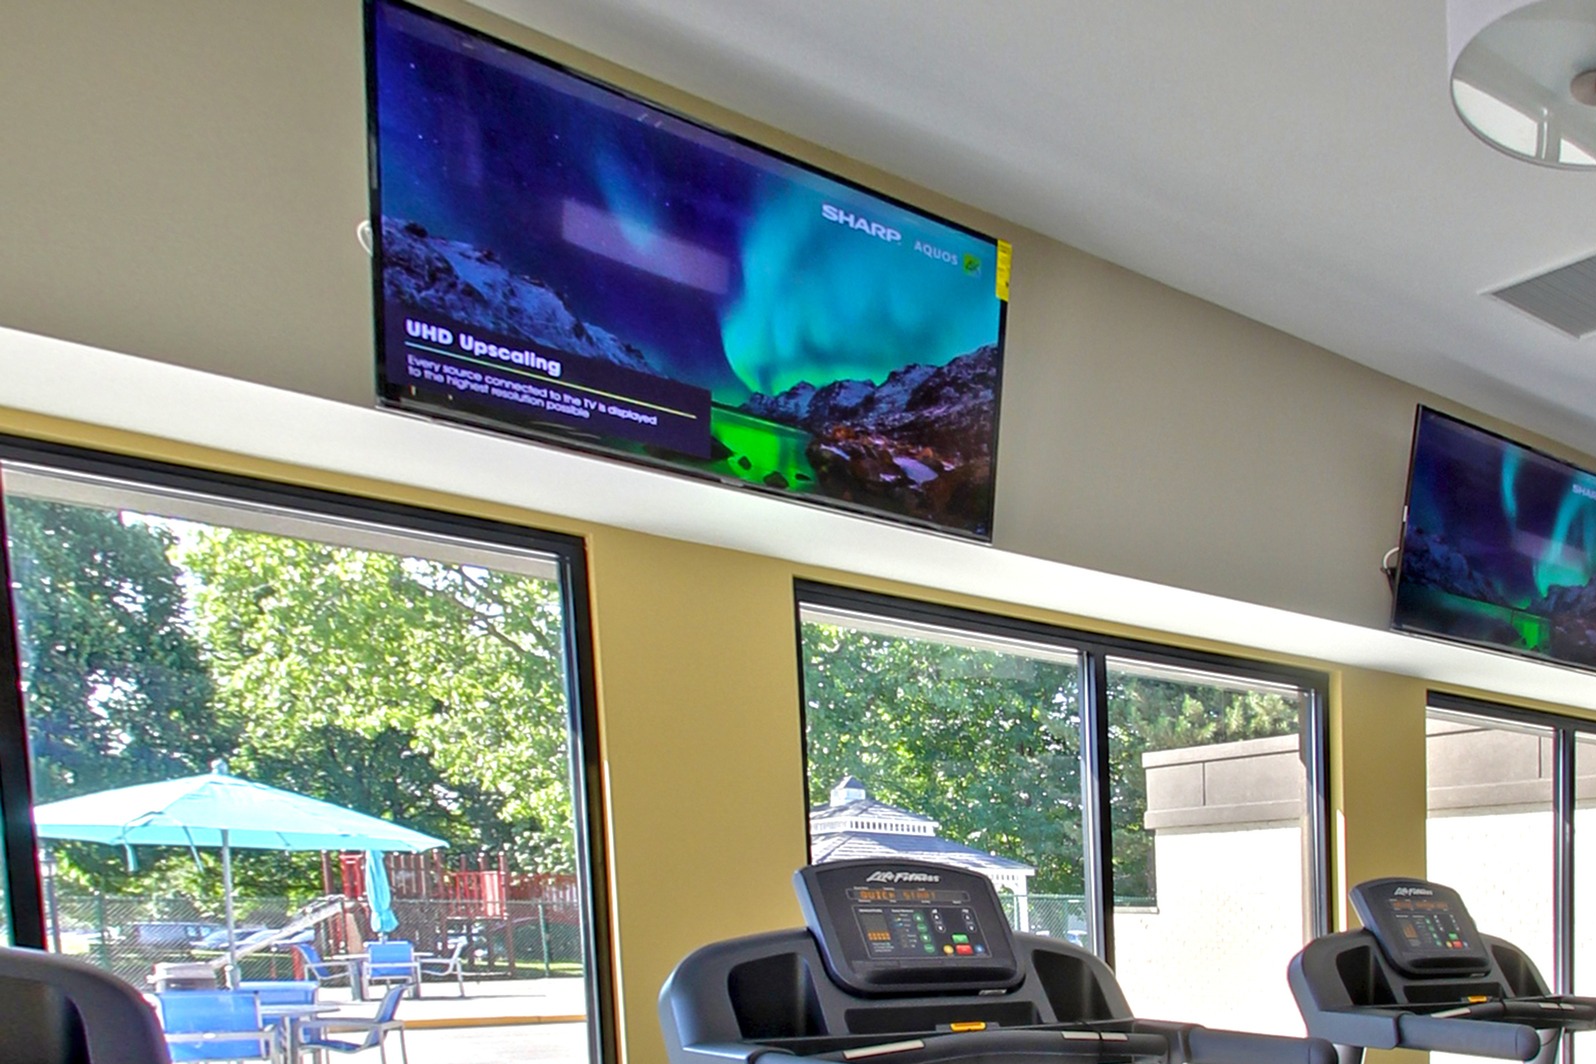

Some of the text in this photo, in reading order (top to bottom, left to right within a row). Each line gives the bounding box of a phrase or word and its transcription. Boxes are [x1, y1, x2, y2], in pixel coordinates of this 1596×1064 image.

[821, 204, 901, 242] SHARP
[914, 241, 958, 265] AQUOS
[405, 319, 561, 377] UHD Upscaling
[407, 354, 657, 425] Every source connected to the TV is displayed
[407, 366, 590, 418] to the highest resolution possible
